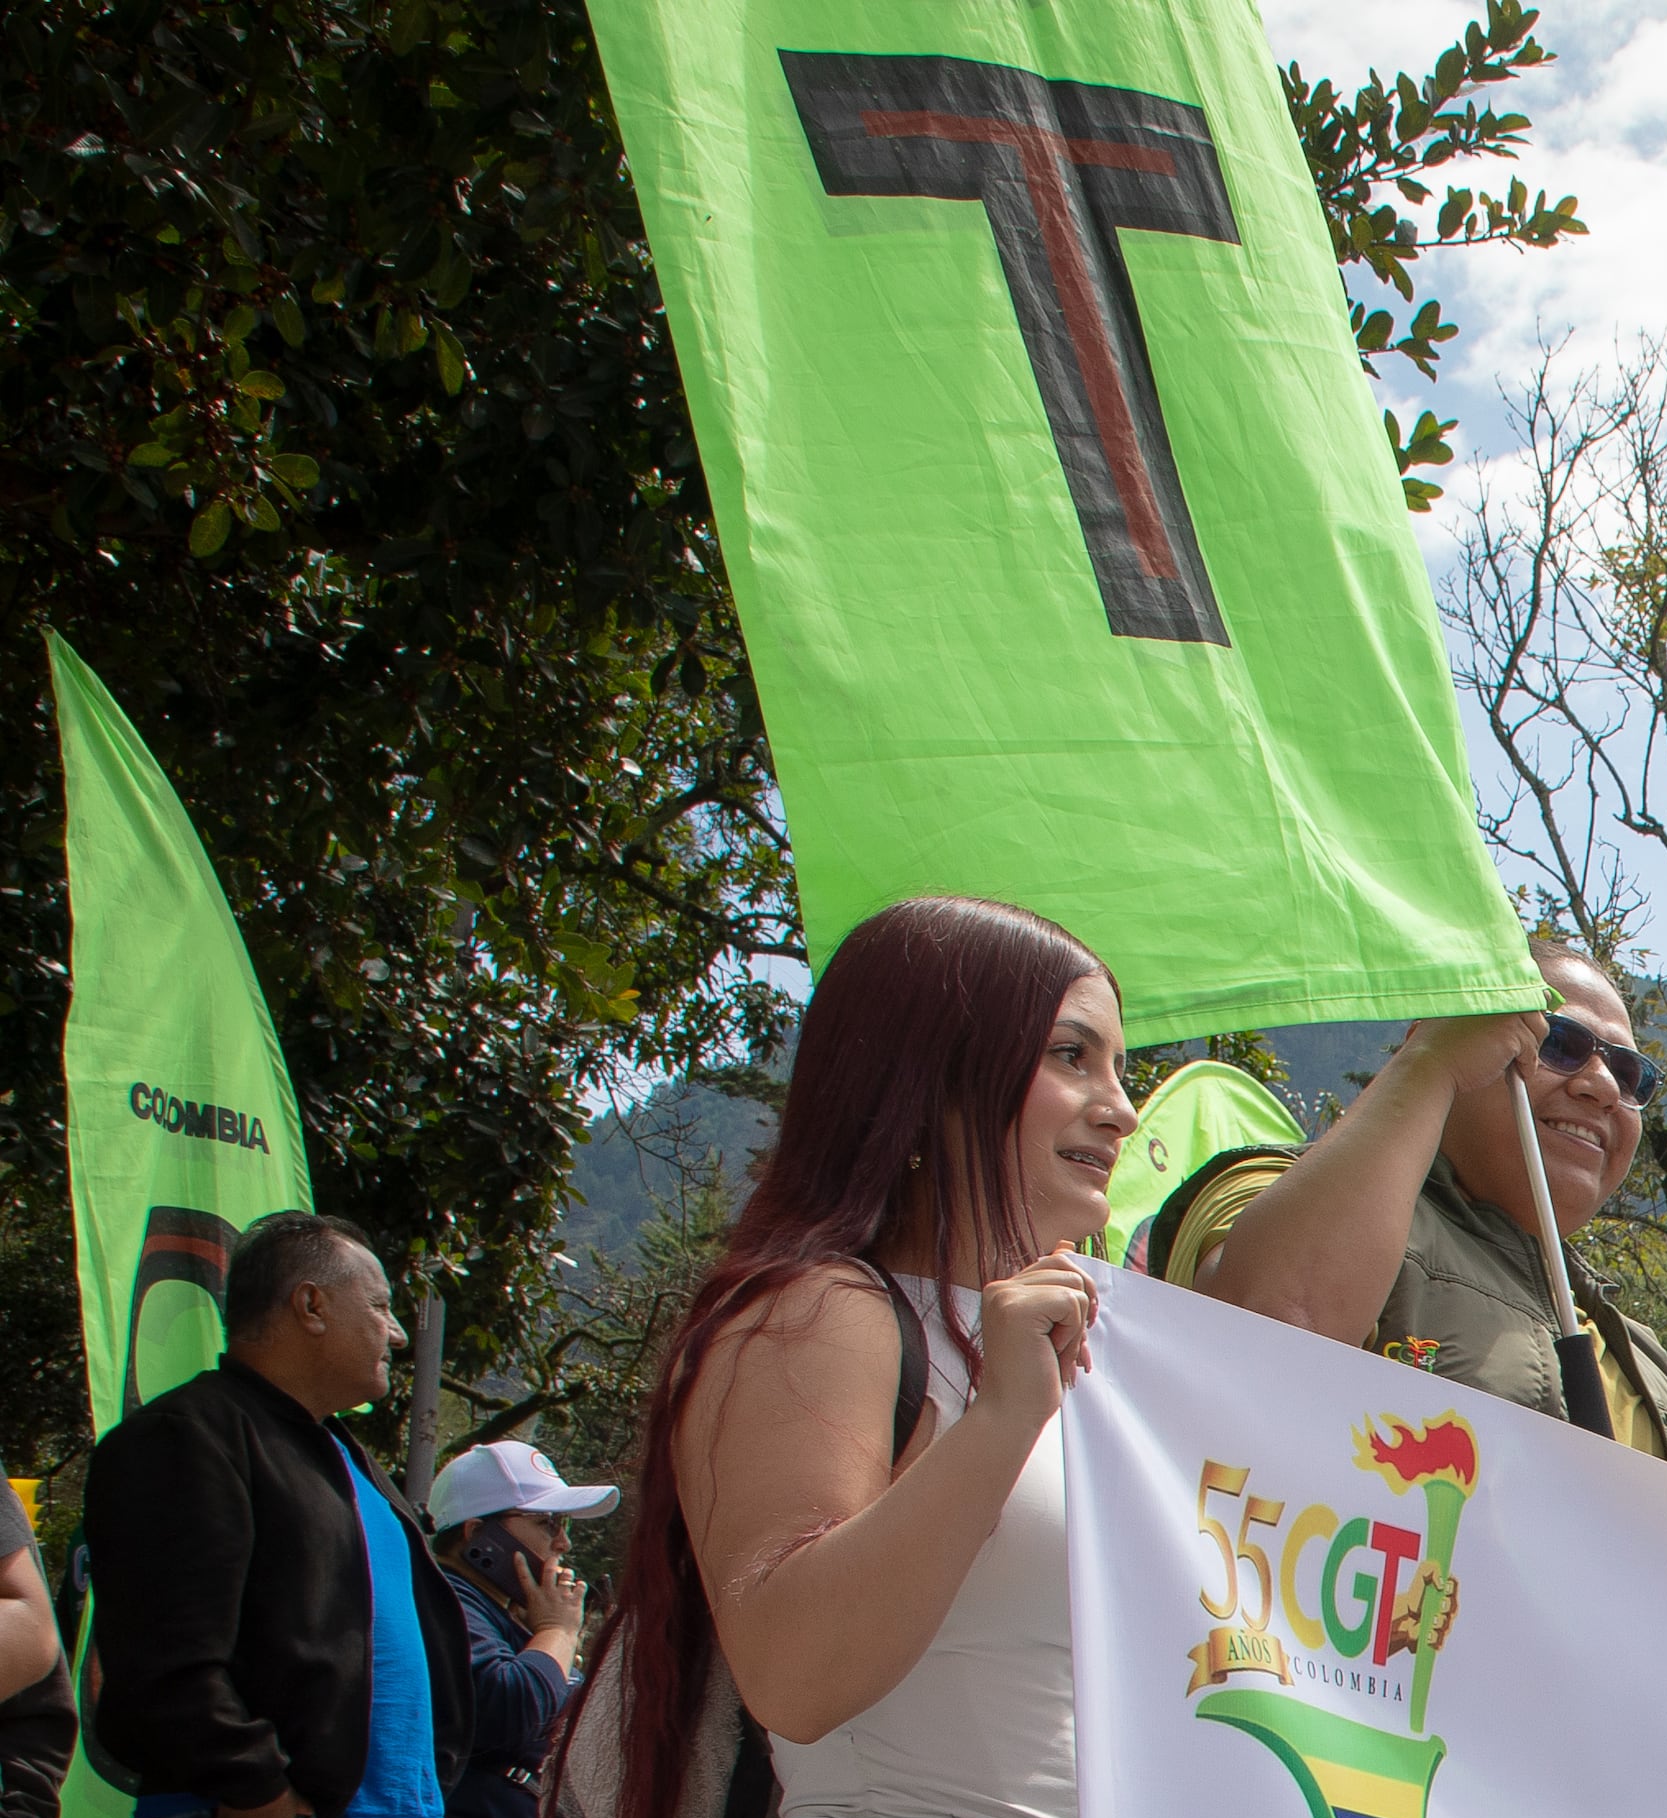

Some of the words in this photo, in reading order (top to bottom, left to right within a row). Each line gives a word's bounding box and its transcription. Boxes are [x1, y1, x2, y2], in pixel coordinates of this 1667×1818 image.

[777, 49, 1241, 648] T
[131, 1082, 270, 1155] COLOMBIA
[1198, 1459, 1286, 1632] 55
[1280, 1504, 1421, 1667] CGT
[1227, 1630, 1271, 1664] AÑOS
[1294, 1657, 1403, 1702] COLOMBIA
